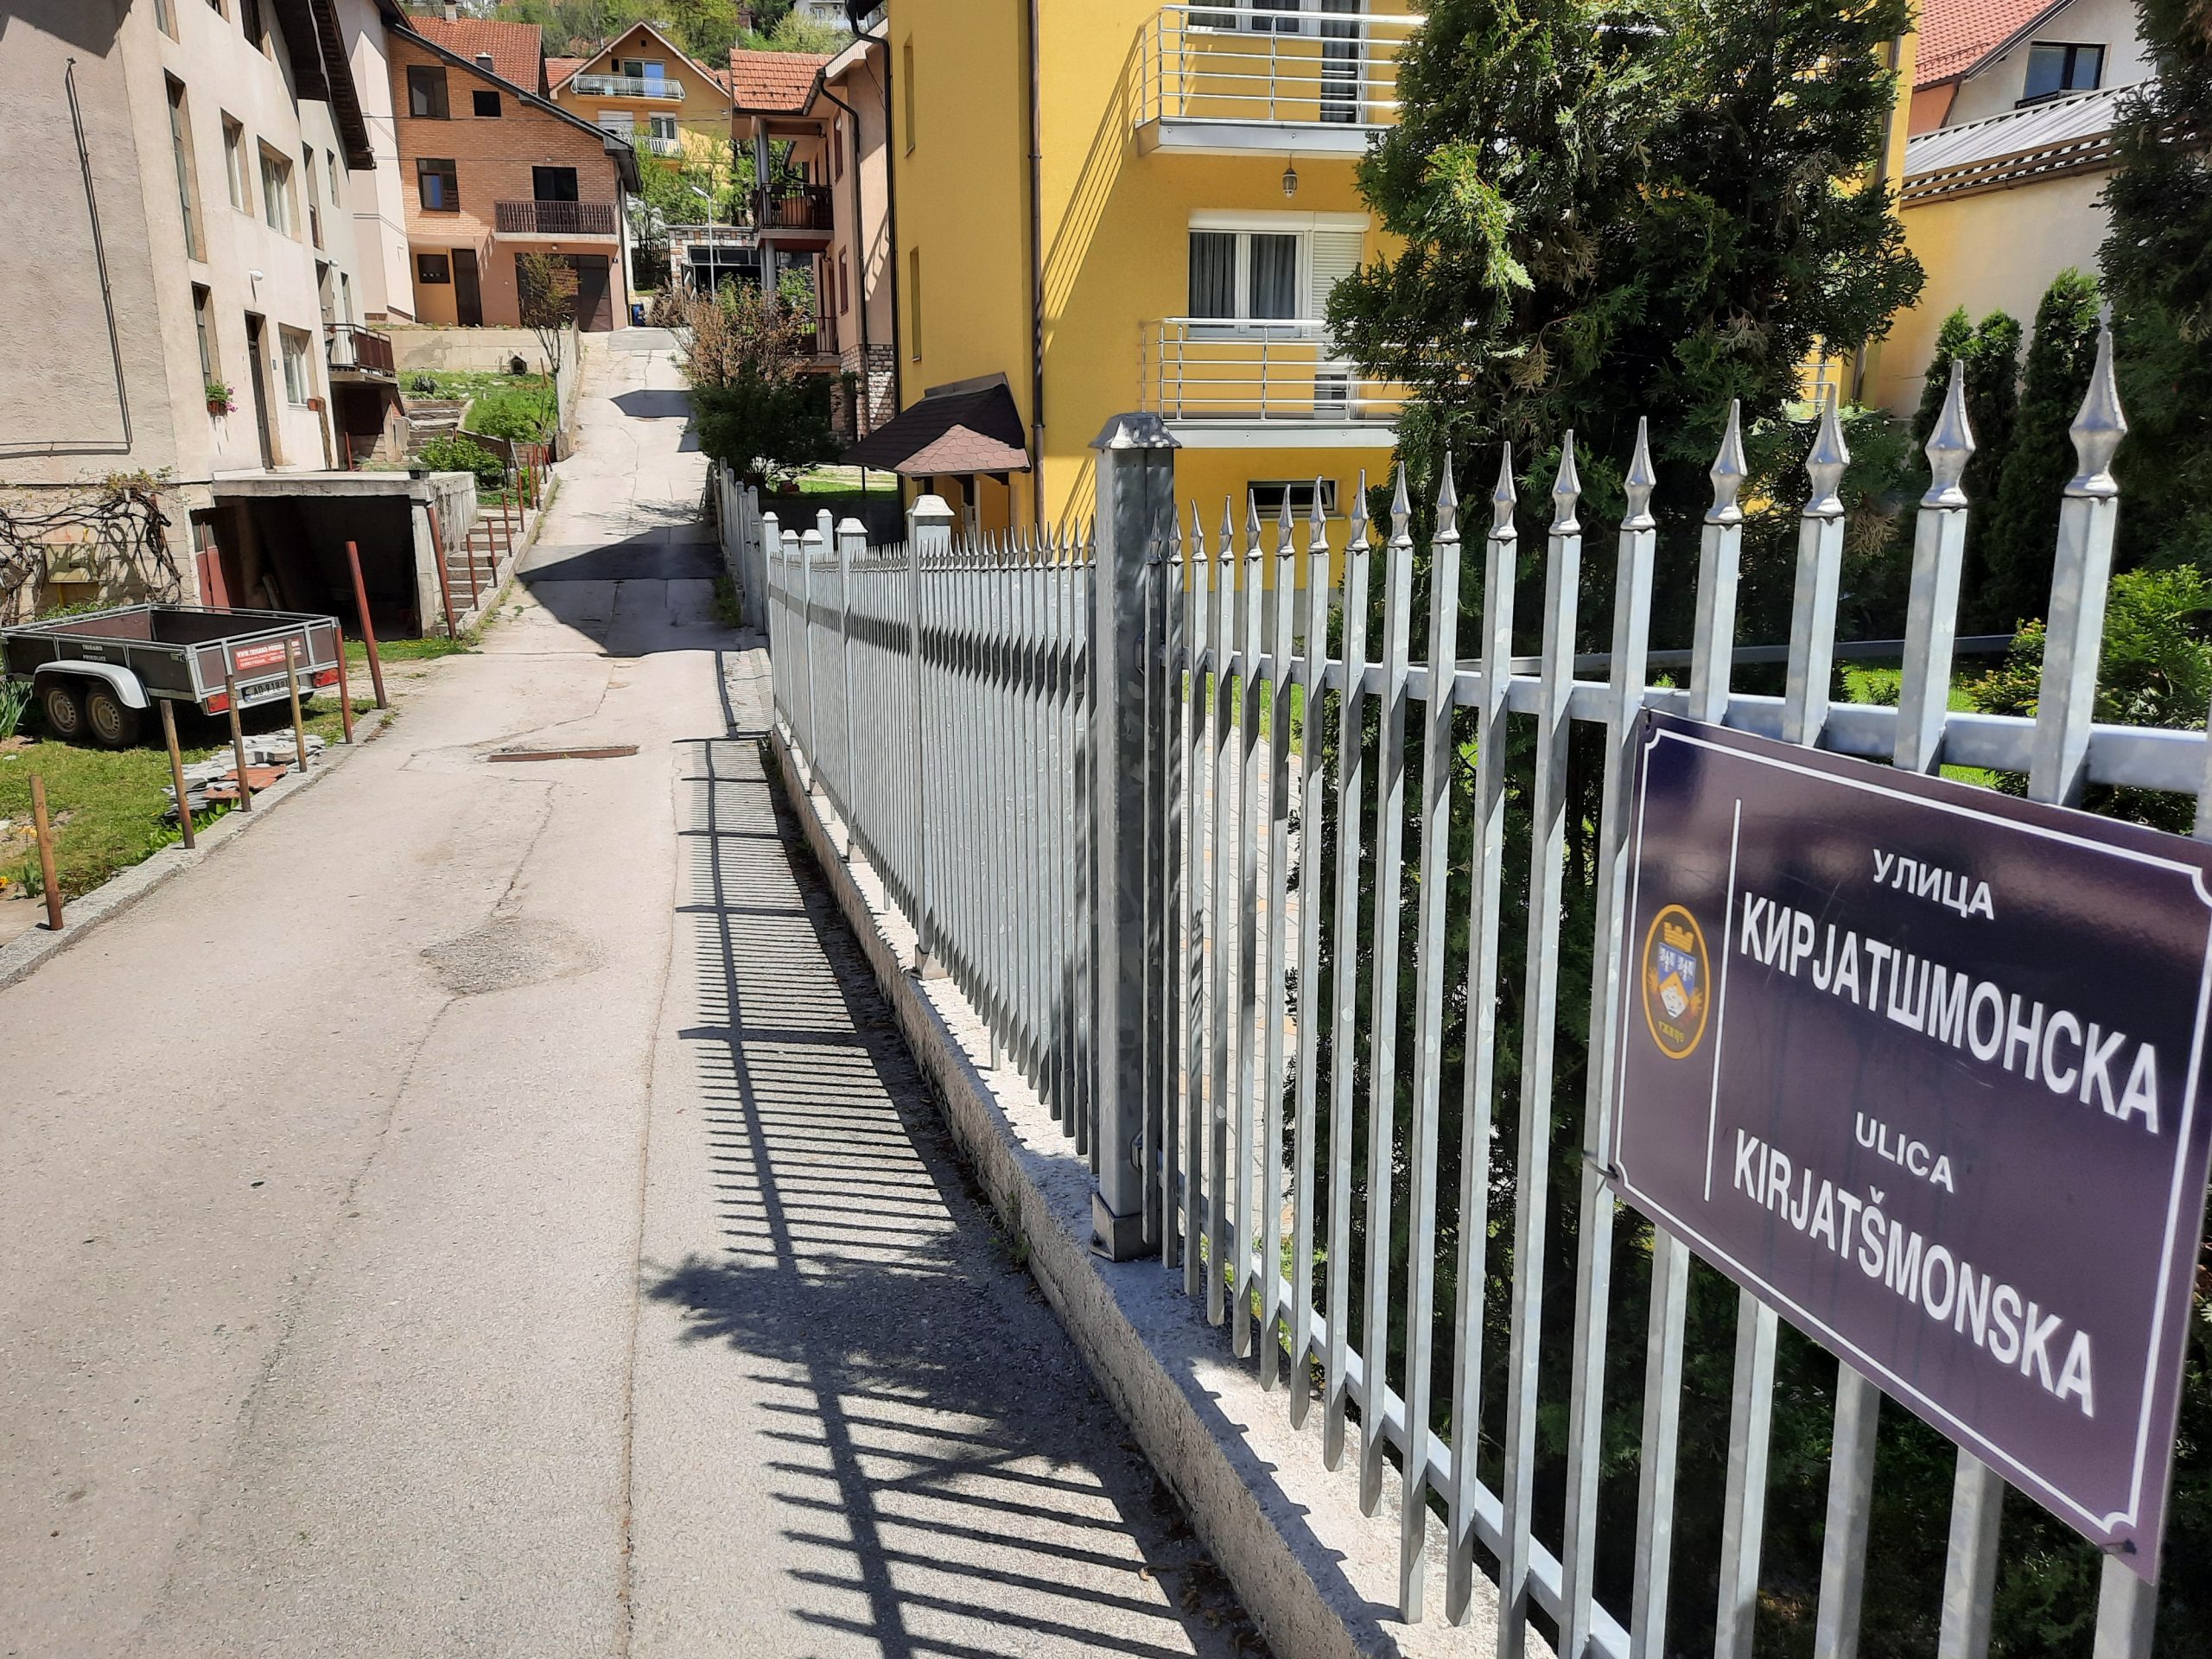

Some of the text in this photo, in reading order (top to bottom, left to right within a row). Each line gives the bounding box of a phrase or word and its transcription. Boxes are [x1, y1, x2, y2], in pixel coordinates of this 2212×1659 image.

[1872, 848, 1995, 921] УЛИЦА
[1739, 891, 2160, 1135] КИРЈАТШМОНСКА
[1854, 1110, 1955, 1194] ULICA
[1732, 1127, 2094, 1419] KIRJATŠMONSKA
